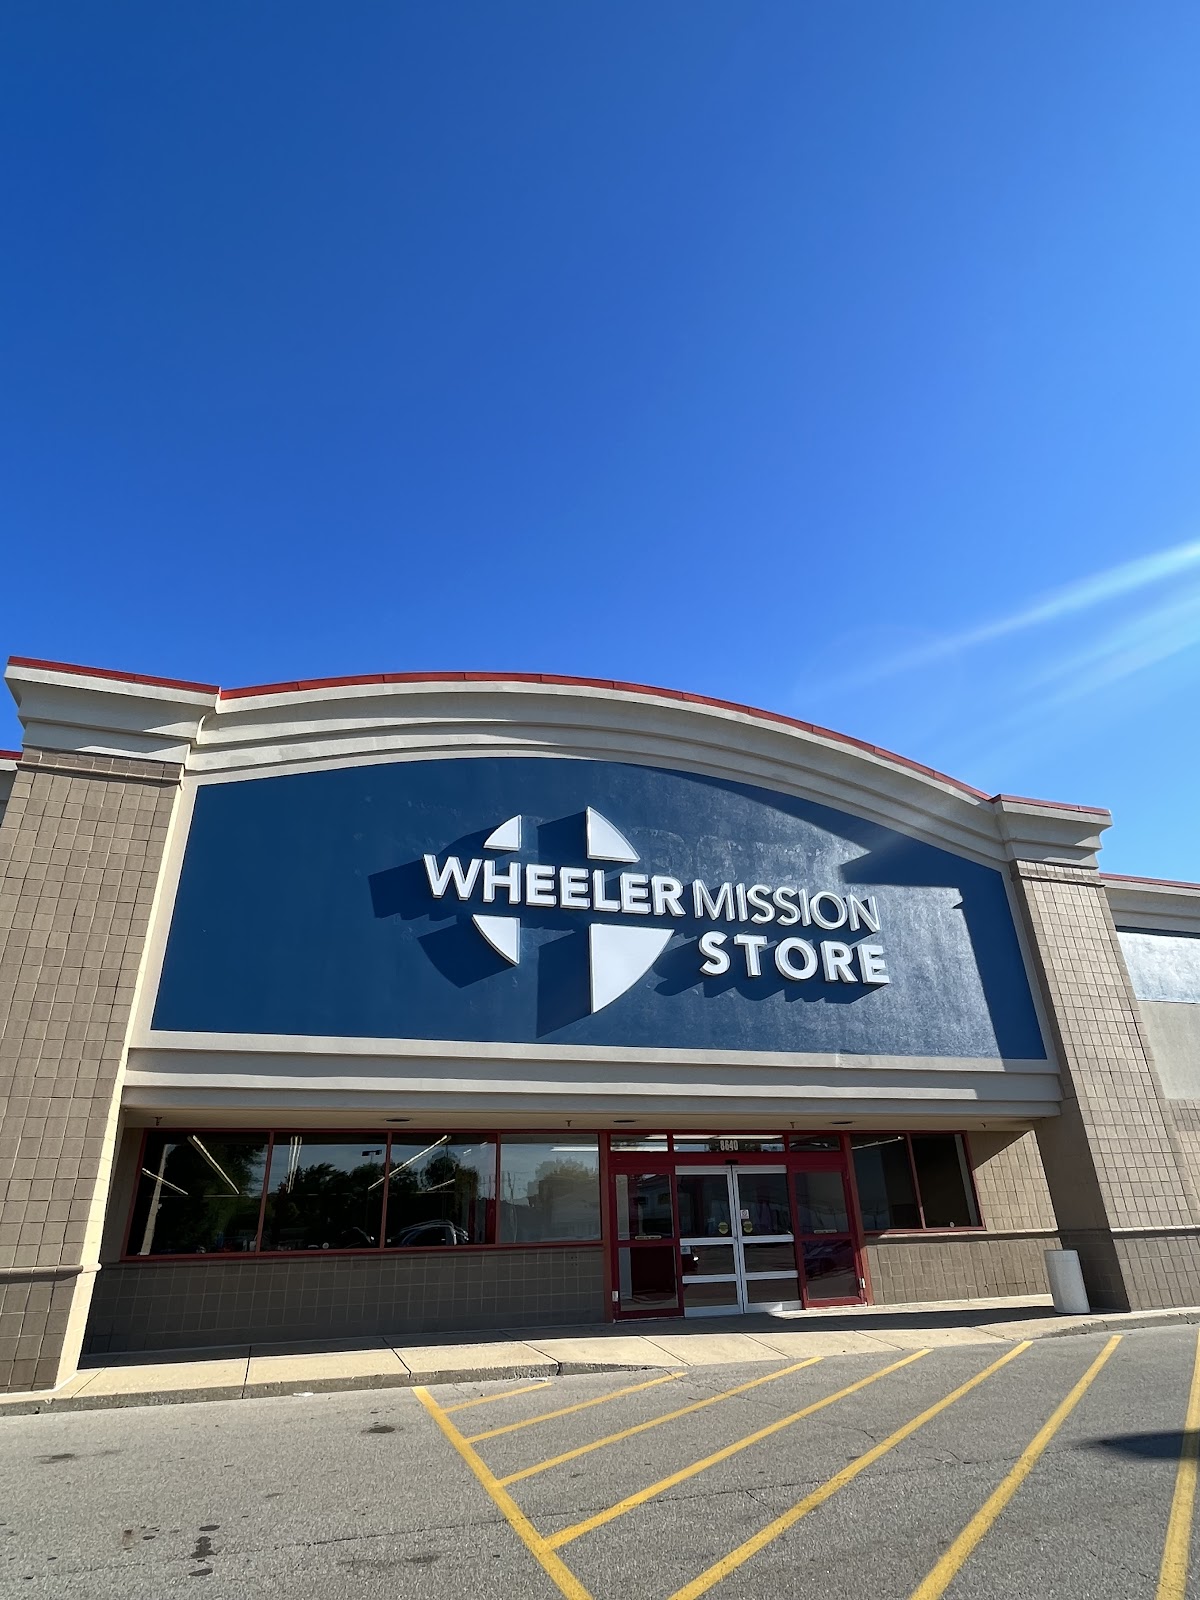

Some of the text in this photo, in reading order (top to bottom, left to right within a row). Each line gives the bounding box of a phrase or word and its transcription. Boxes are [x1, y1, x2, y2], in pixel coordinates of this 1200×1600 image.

[423, 853, 882, 933] WHEELER MISSION
[698, 931, 891, 985] STORE
[720, 1140, 738, 1151] 8640
